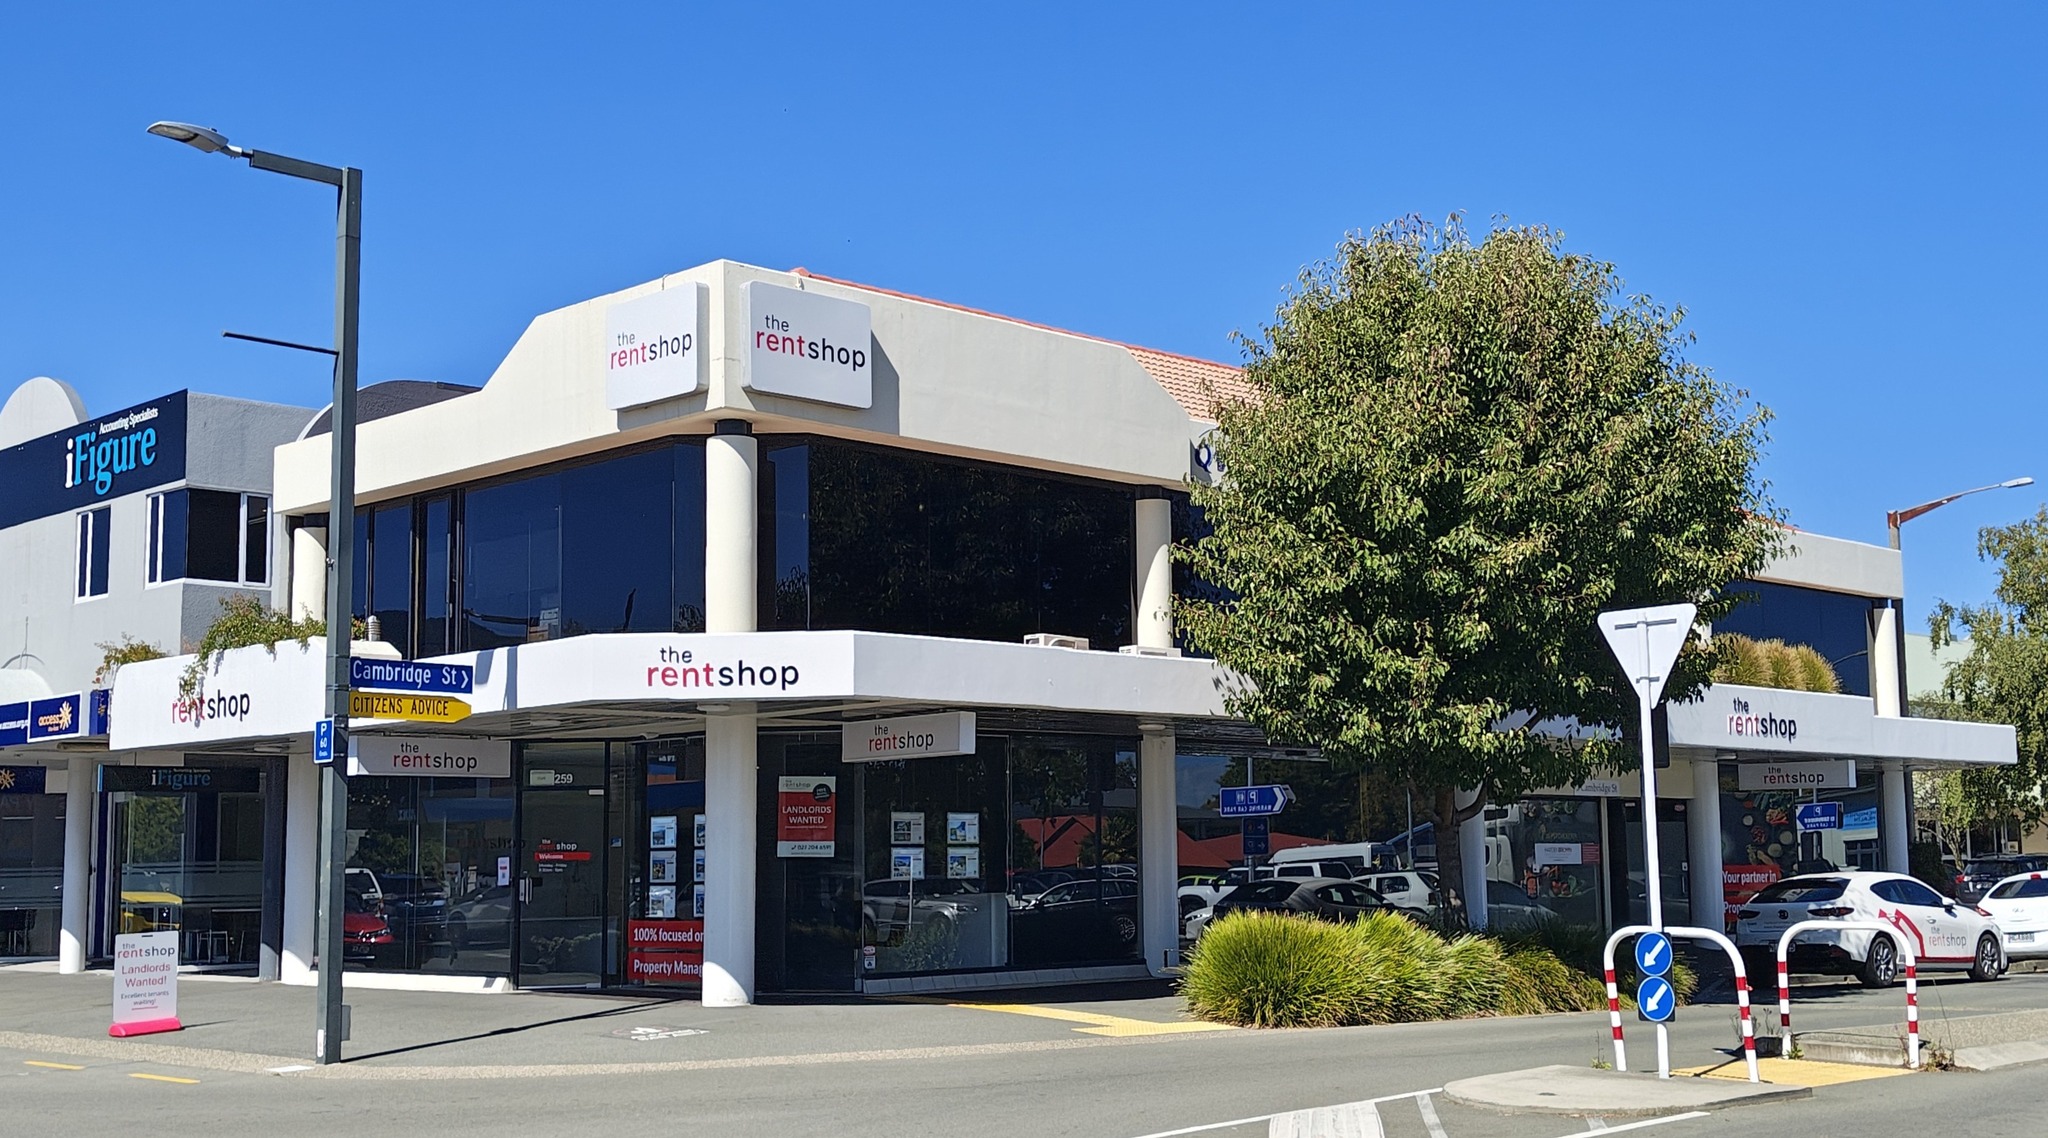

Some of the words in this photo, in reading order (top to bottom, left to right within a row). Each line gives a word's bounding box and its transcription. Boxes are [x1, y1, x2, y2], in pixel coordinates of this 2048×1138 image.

[764, 315, 789, 332] the
[617, 333, 635, 347] the
[611, 333, 692, 370] rentshop
[755, 331, 866, 371] rentshop
[99, 415, 129, 435] Accounting
[129, 407, 158, 428] Specialists
[65, 428, 157, 495] iFigure
[660, 646, 693, 664] the
[353, 660, 431, 689] Cambridge
[442, 666, 457, 685] St
[647, 660, 800, 691] rentshop
[353, 697, 403, 714] CITIZENS
[410, 700, 449, 716] ADVICE
[1733, 697, 1750, 713] the
[320, 723, 328, 736] P
[874, 724, 889, 736] the
[1727, 712, 1797, 742] rentshop
[400, 742, 419, 753] the
[868, 732, 934, 752] rentshop
[393, 752, 478, 772] rentshop
[1768, 766, 1782, 774] the
[152, 769, 211, 789] iFigure
[554, 773, 574, 784] 259
[1763, 772, 1825, 785] rentshop
[782, 806, 832, 814] LANDLORDS
[788, 816, 825, 824] WANTED
[1722, 871, 1740, 883] Your
[1741, 872, 1768, 886] partner
[1769, 870, 1777, 883] in
[633, 927, 657, 942] 100%
[659, 927, 692, 942] focused
[1931, 926, 1941, 935] the
[1928, 933, 1967, 949] rentshop
[117, 946, 175, 959] rentshop
[121, 963, 171, 975] Landlords
[633, 958, 673, 977] Property
[125, 976, 167, 988] Wanted!
[121, 992, 147, 1000] Excellent
